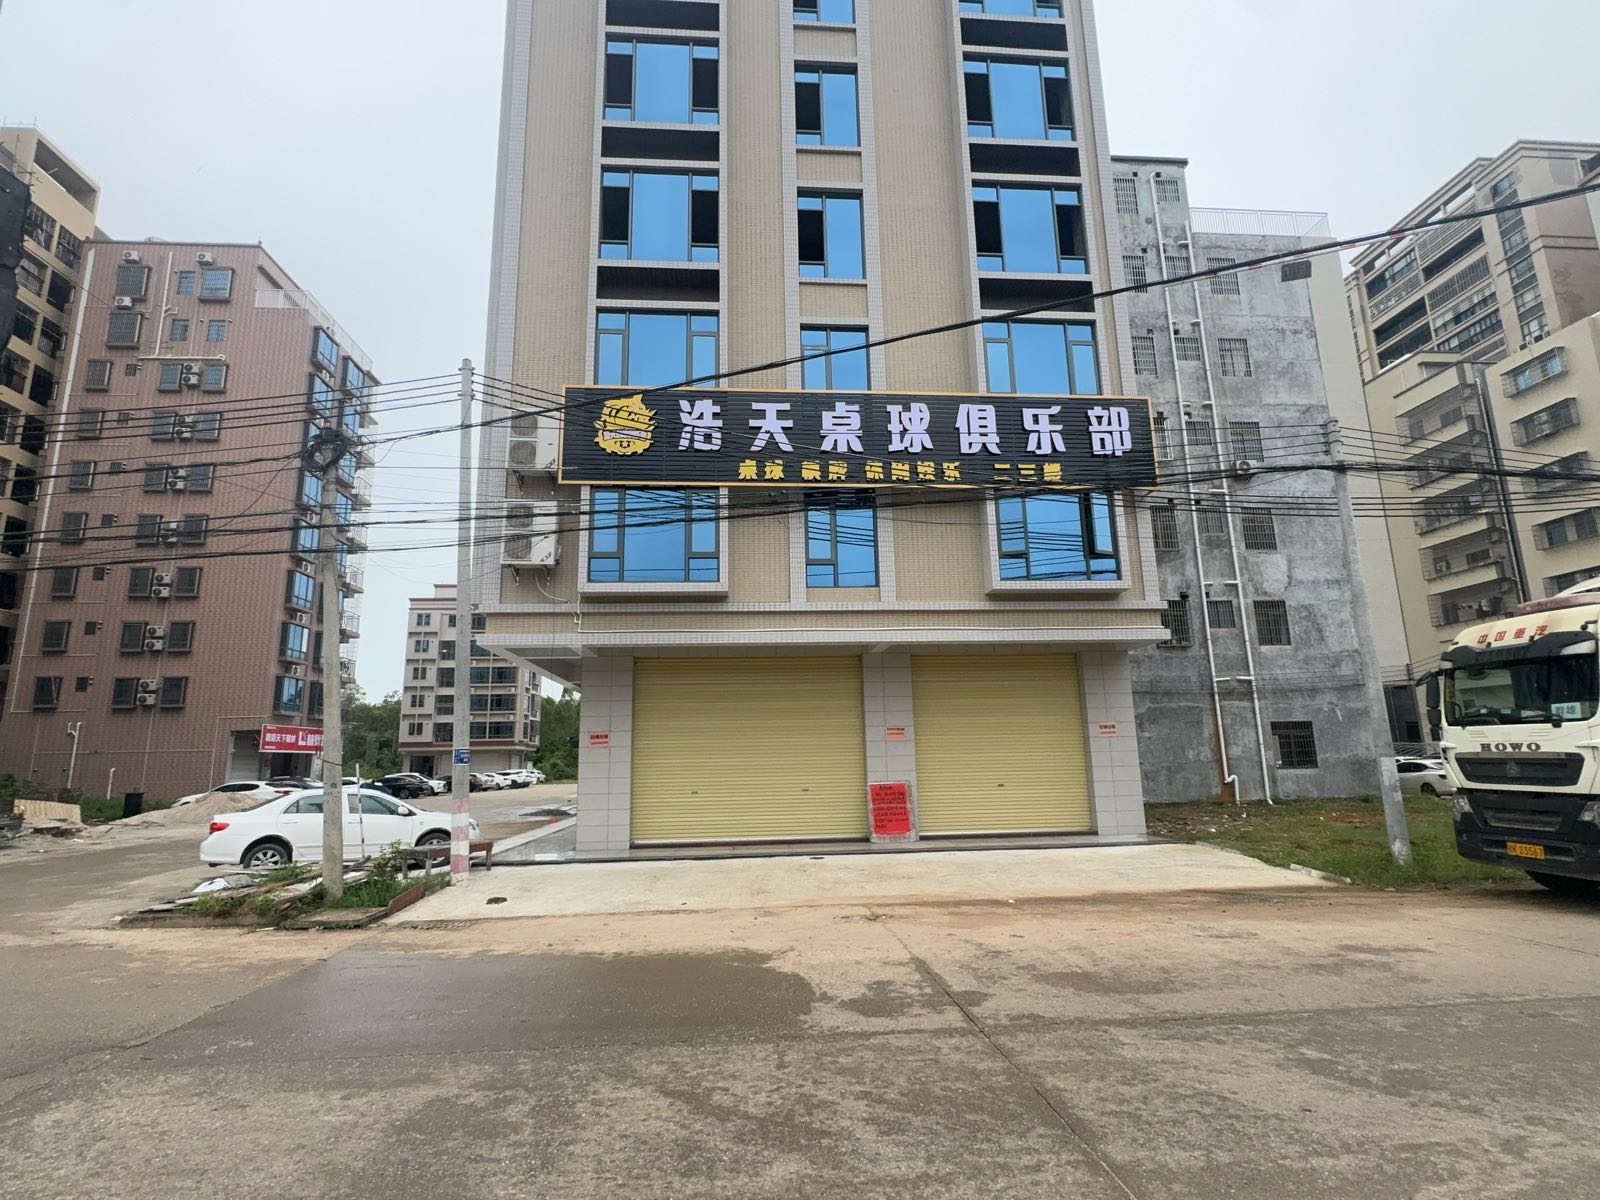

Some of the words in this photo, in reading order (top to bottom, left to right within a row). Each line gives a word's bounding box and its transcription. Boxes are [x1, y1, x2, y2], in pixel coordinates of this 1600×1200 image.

[678, 399, 1132, 456] 浩天桌球俱乐部
[1480, 742, 1541, 752] HOWO
